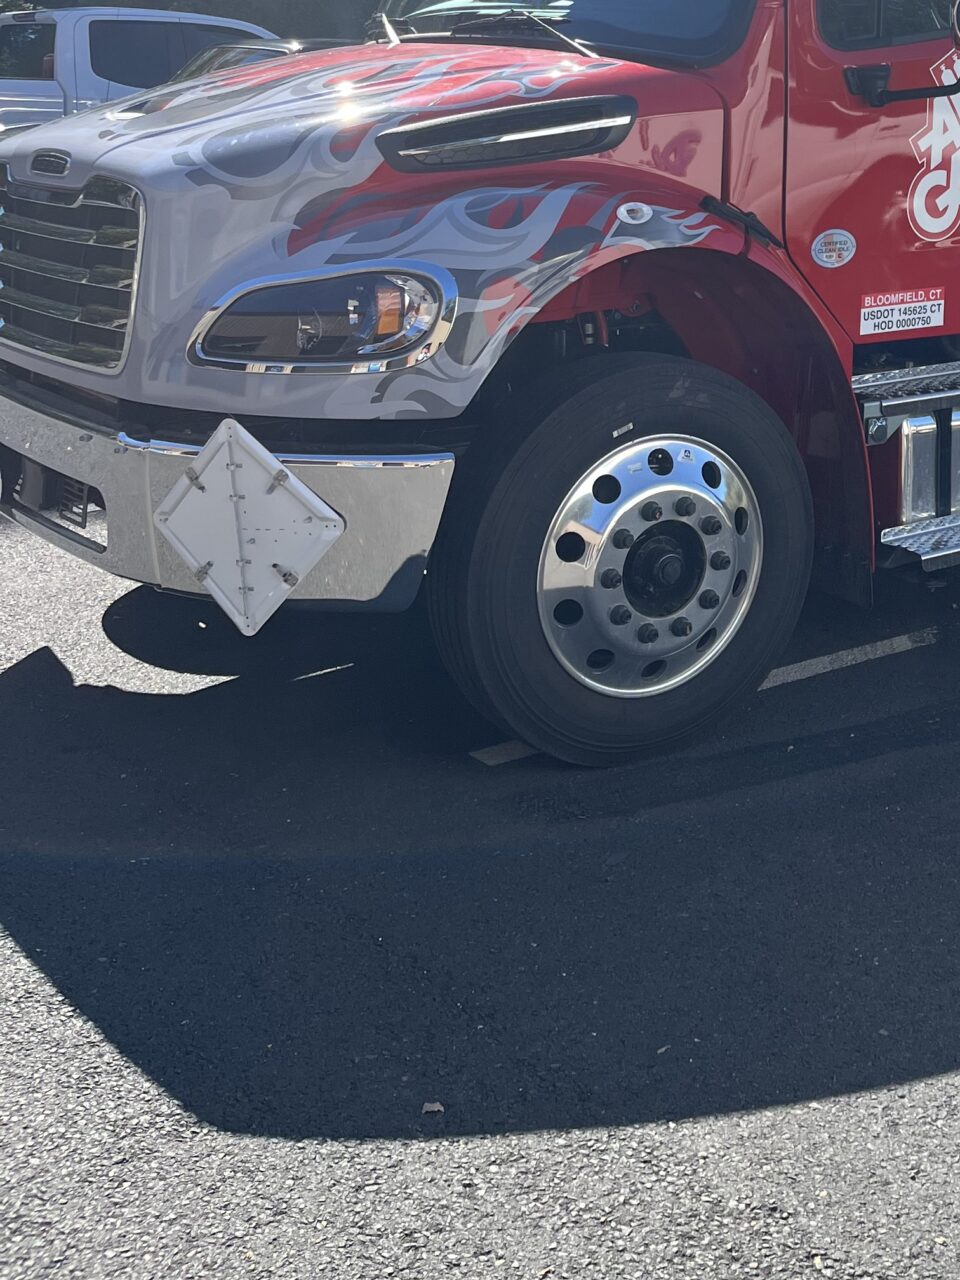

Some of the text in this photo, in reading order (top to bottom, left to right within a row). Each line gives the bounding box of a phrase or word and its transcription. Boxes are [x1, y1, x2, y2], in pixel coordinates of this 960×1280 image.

[864, 289, 942, 307] BLOOMFIELD, CT
[863, 303, 942, 321] USDOT 145625 CT
[873, 316, 931, 331] HOD 0000750
